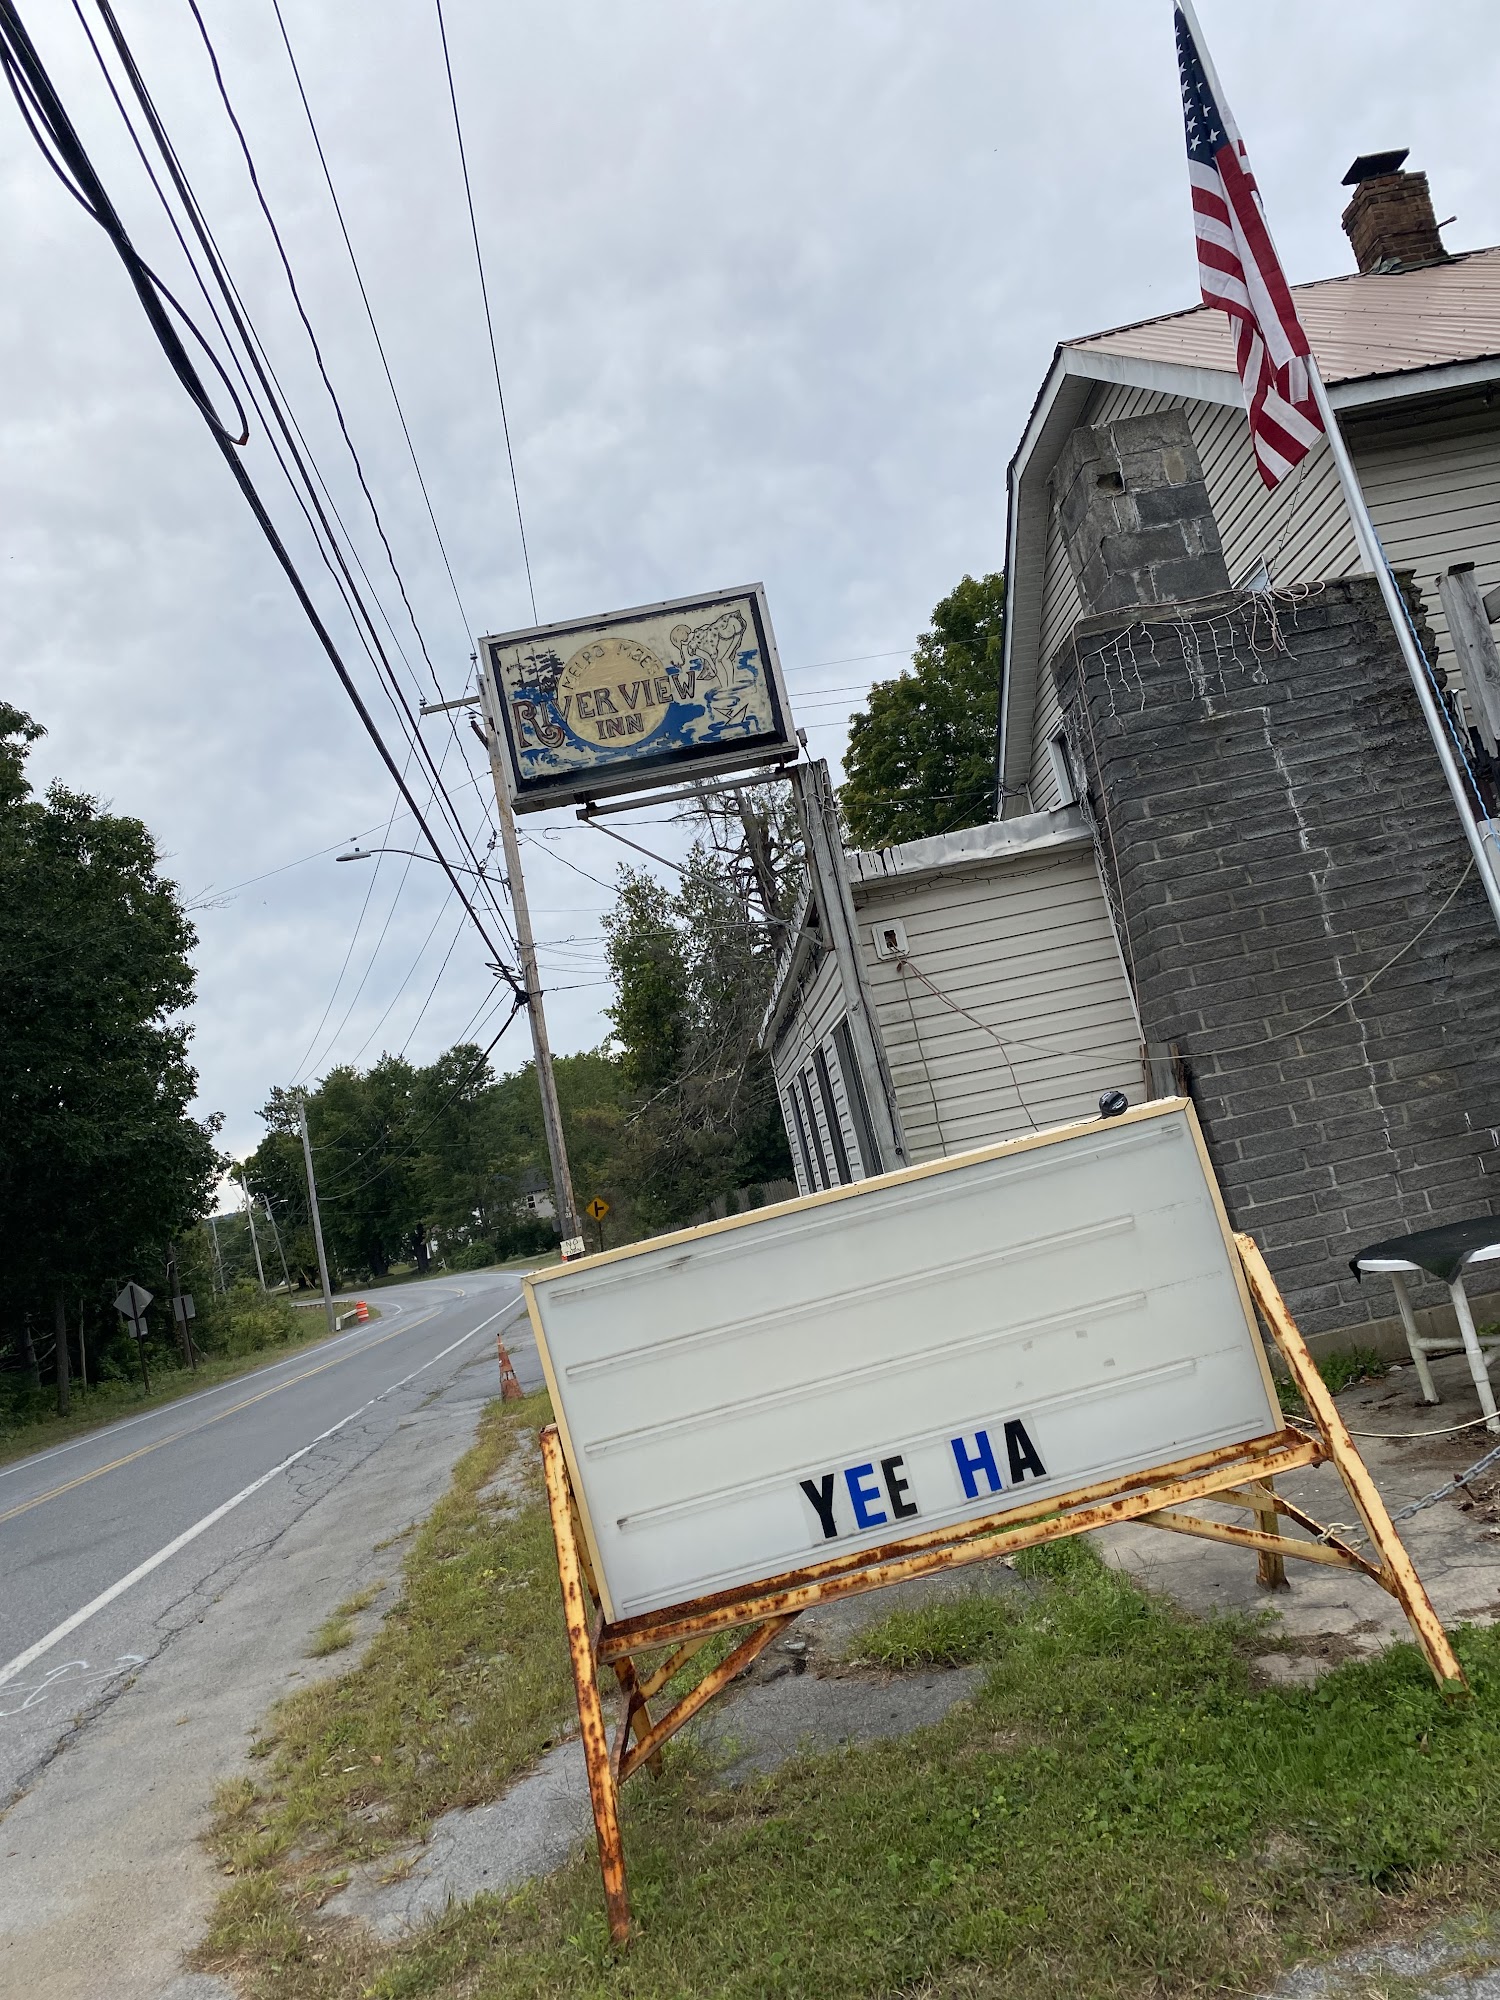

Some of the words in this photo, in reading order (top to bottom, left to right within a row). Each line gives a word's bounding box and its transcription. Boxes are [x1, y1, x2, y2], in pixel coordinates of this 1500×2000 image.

[595, 712, 645, 741] INN
[565, 1238, 579, 1248] NO
[799, 1455, 919, 1539] YEE
[950, 1418, 1047, 1499] HA
